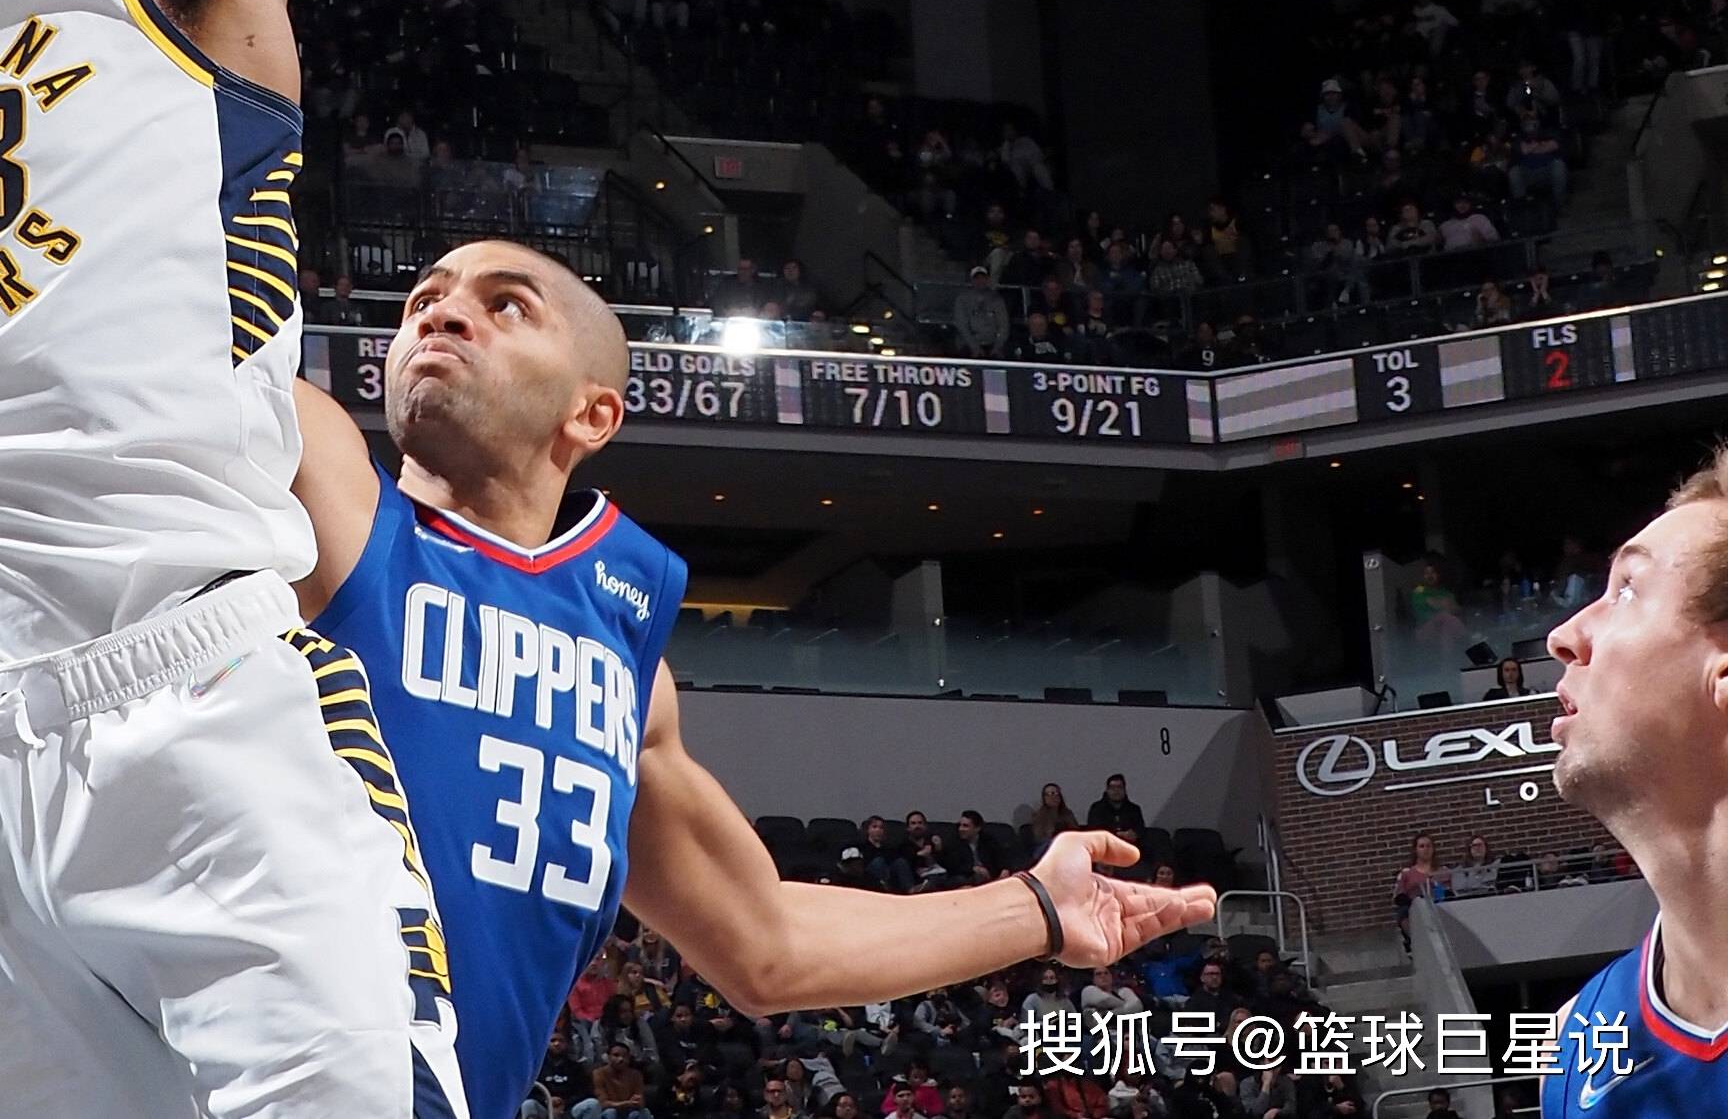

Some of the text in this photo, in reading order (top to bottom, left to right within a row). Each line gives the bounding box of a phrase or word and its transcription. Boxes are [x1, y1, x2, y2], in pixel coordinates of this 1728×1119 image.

[1532, 324, 1578, 348] FLS
[631, 351, 756, 377] ELD GOALS
[811, 361, 972, 387] FREE THROWS
[1372, 349, 1419, 373] TOL
[1544, 349, 1572, 389] 2
[624, 376, 746, 418] 33/67
[1033, 371, 1160, 397] 3-POINT FG
[1386, 375, 1412, 412] 3
[843, 387, 943, 427] 7/10
[1051, 397, 1142, 437] 9/21
[593, 559, 652, 622] honey
[401, 582, 640, 788] CLIPPERS
[1160, 727, 1171, 756] 8
[1485, 781, 1539, 807] LO
[471, 733, 613, 913] 33
